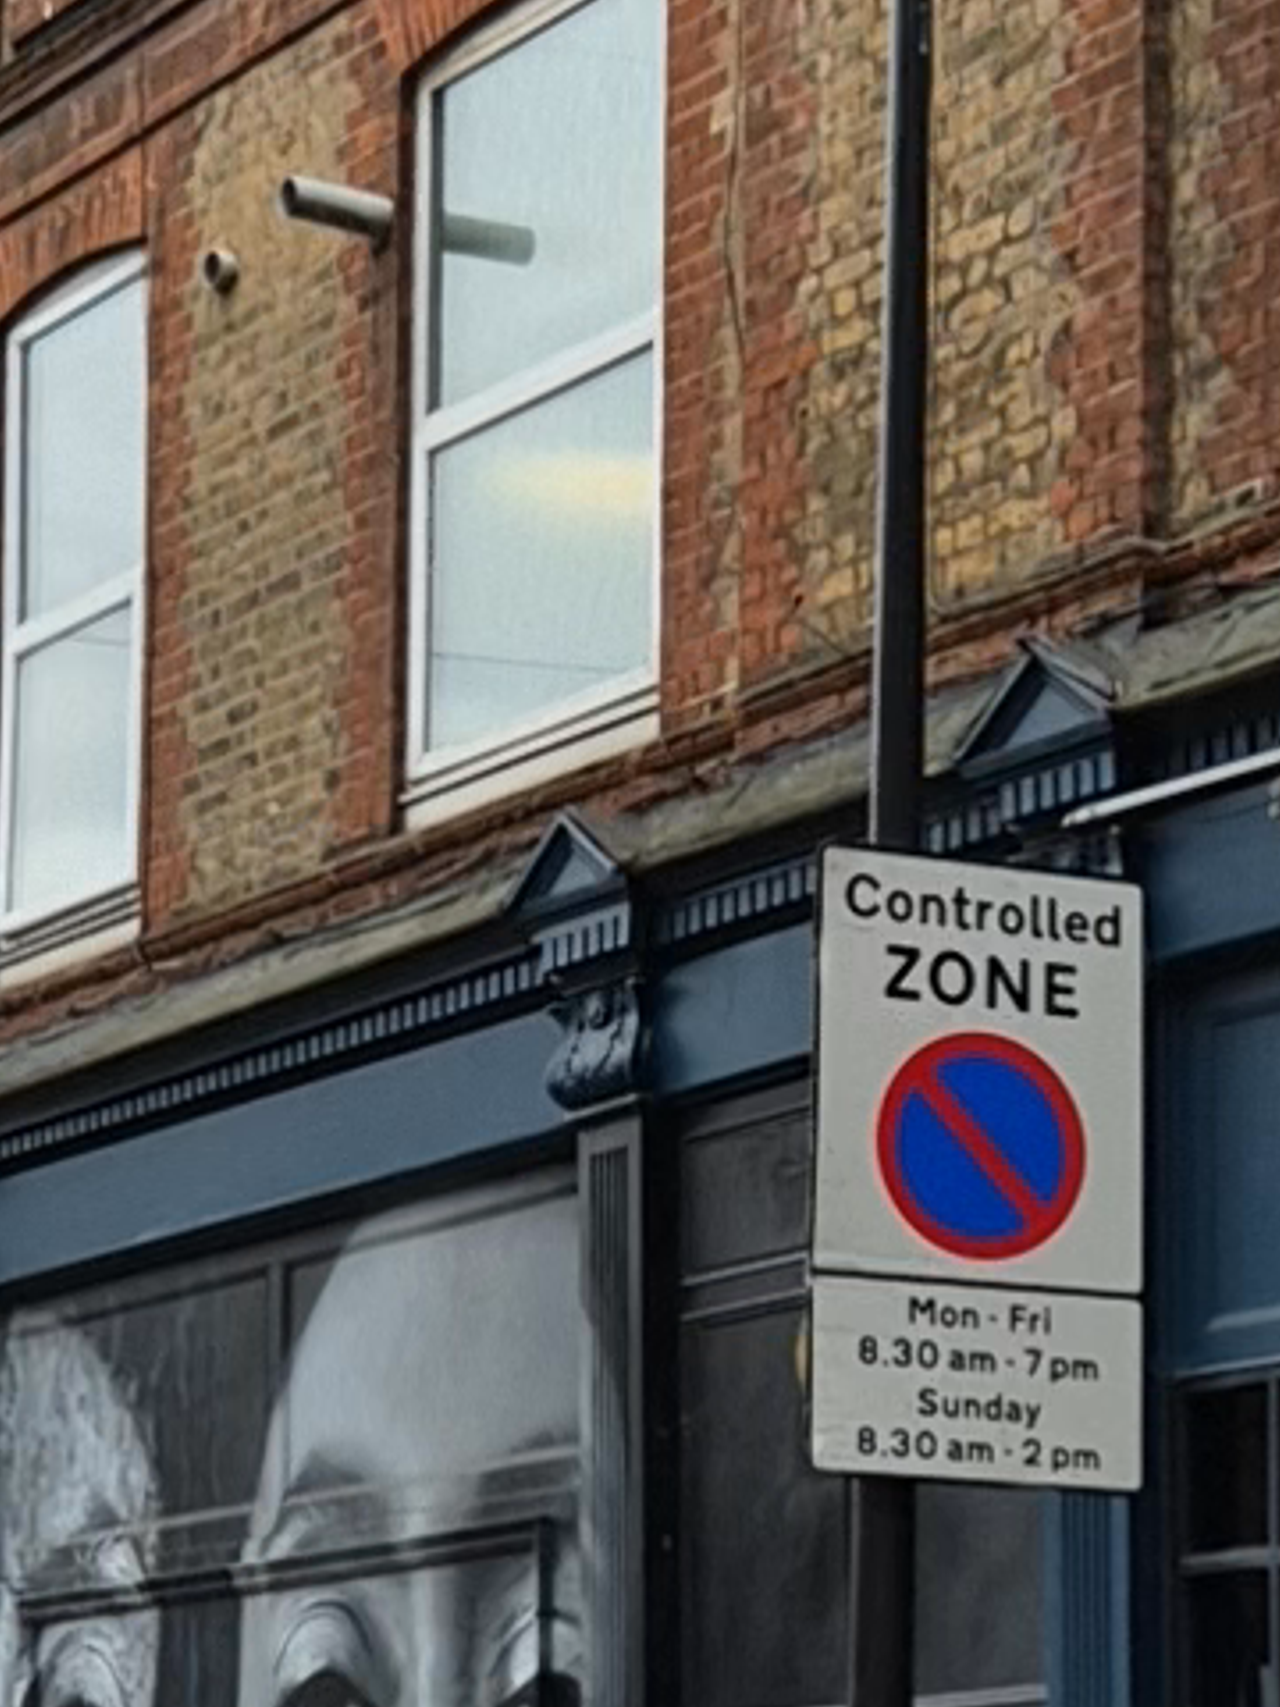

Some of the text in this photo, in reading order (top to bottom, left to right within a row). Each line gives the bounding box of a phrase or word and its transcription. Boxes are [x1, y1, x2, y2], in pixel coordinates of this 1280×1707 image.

[844, 872, 1121, 947] Controlled
[884, 944, 1080, 1019] ZONE
[908, 1296, 980, 1329] Mon
[1009, 1303, 1052, 1335] Fri
[858, 1335, 939, 1370] 8.30
[948, 1348, 997, 1374] am
[1023, 1347, 1043, 1378] 7
[1049, 1356, 1099, 1383] pm
[917, 1388, 1042, 1430] Sunday
[857, 1425, 938, 1461] 8.30
[946, 1438, 995, 1464] am
[1022, 1438, 1042, 1468] 2
[1050, 1445, 1102, 1474] pm
